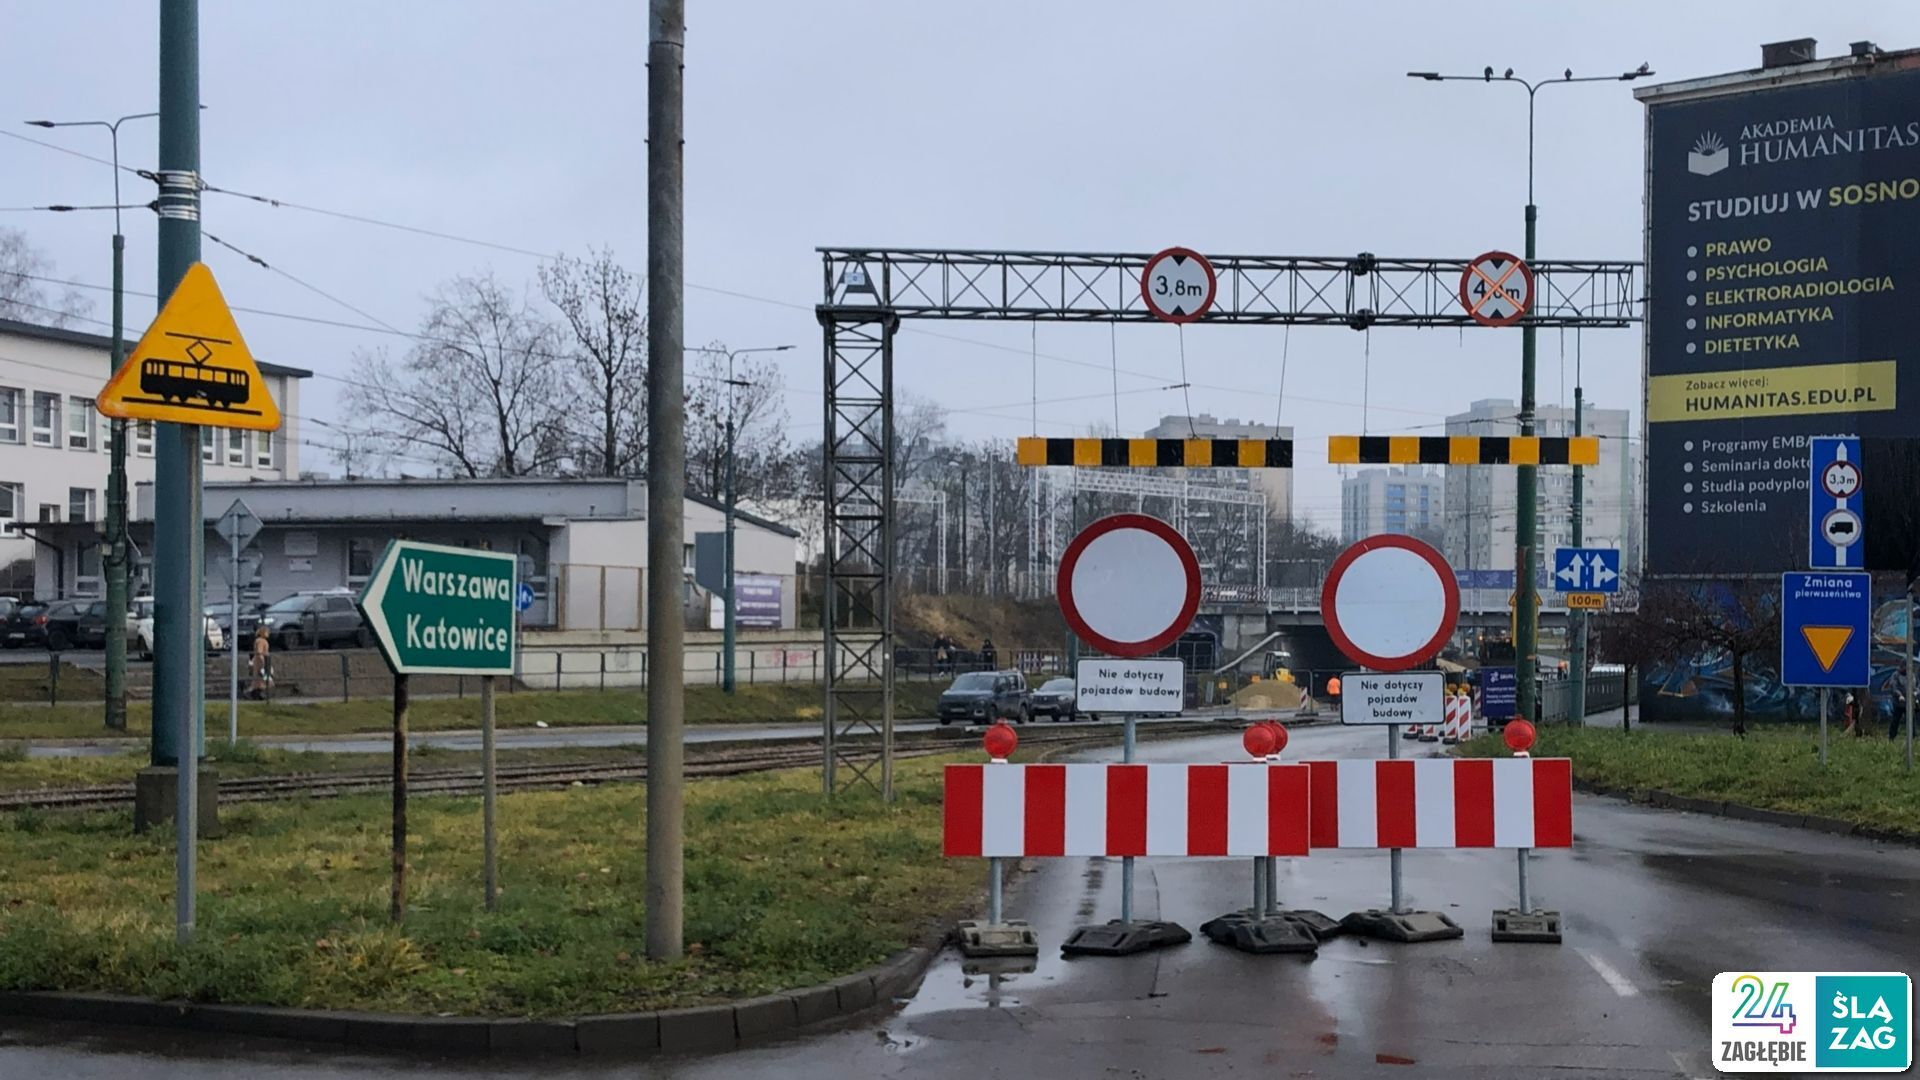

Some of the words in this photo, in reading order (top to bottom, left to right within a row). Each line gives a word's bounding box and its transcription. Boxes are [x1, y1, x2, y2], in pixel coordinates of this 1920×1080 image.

[1740, 114, 1834, 140] AKADEMIA
[1740, 121, 1920, 166] HUMANITAS
[1687, 192, 1789, 222] STUDIUJ
[1796, 188, 1822, 210] W
[1705, 237, 1772, 257] PRAWO
[1705, 256, 1829, 282] PSYCHOLOGIA
[1155, 274, 1202, 298] 3,8m
[1705, 275, 1895, 306] ELEKTRORADIOLOGIA
[1705, 305, 1834, 330] INFORMATYKA
[1705, 333, 1800, 354] DIETETYKA
[1685, 380, 1726, 391] Zobacz
[1728, 375, 1770, 389] więcej:
[1685, 386, 1877, 412] HUMANITAS.EDU.PL
[1702, 439, 1768, 454] Programy
[1702, 457, 1770, 473] Seminaria
[1701, 479, 1745, 493] Studia
[1701, 499, 1767, 514] Szkolenia
[402, 556, 510, 601] Warszawa
[1804, 576, 1853, 589] Zmiana
[1572, 595, 1602, 606] 100m
[1795, 588, 1862, 599] pierwszeństwa
[406, 613, 508, 652] Katowice
[1098, 668, 1118, 679] Nie
[1123, 669, 1164, 682] dotyczy
[1081, 684, 1134, 697] pojazdów
[1139, 686, 1181, 699] budowy
[1360, 680, 1379, 690] Nie
[1384, 680, 1424, 692] dotyczy
[1367, 694, 1418, 706] pojazdów
[1372, 707, 1413, 720] budowy
